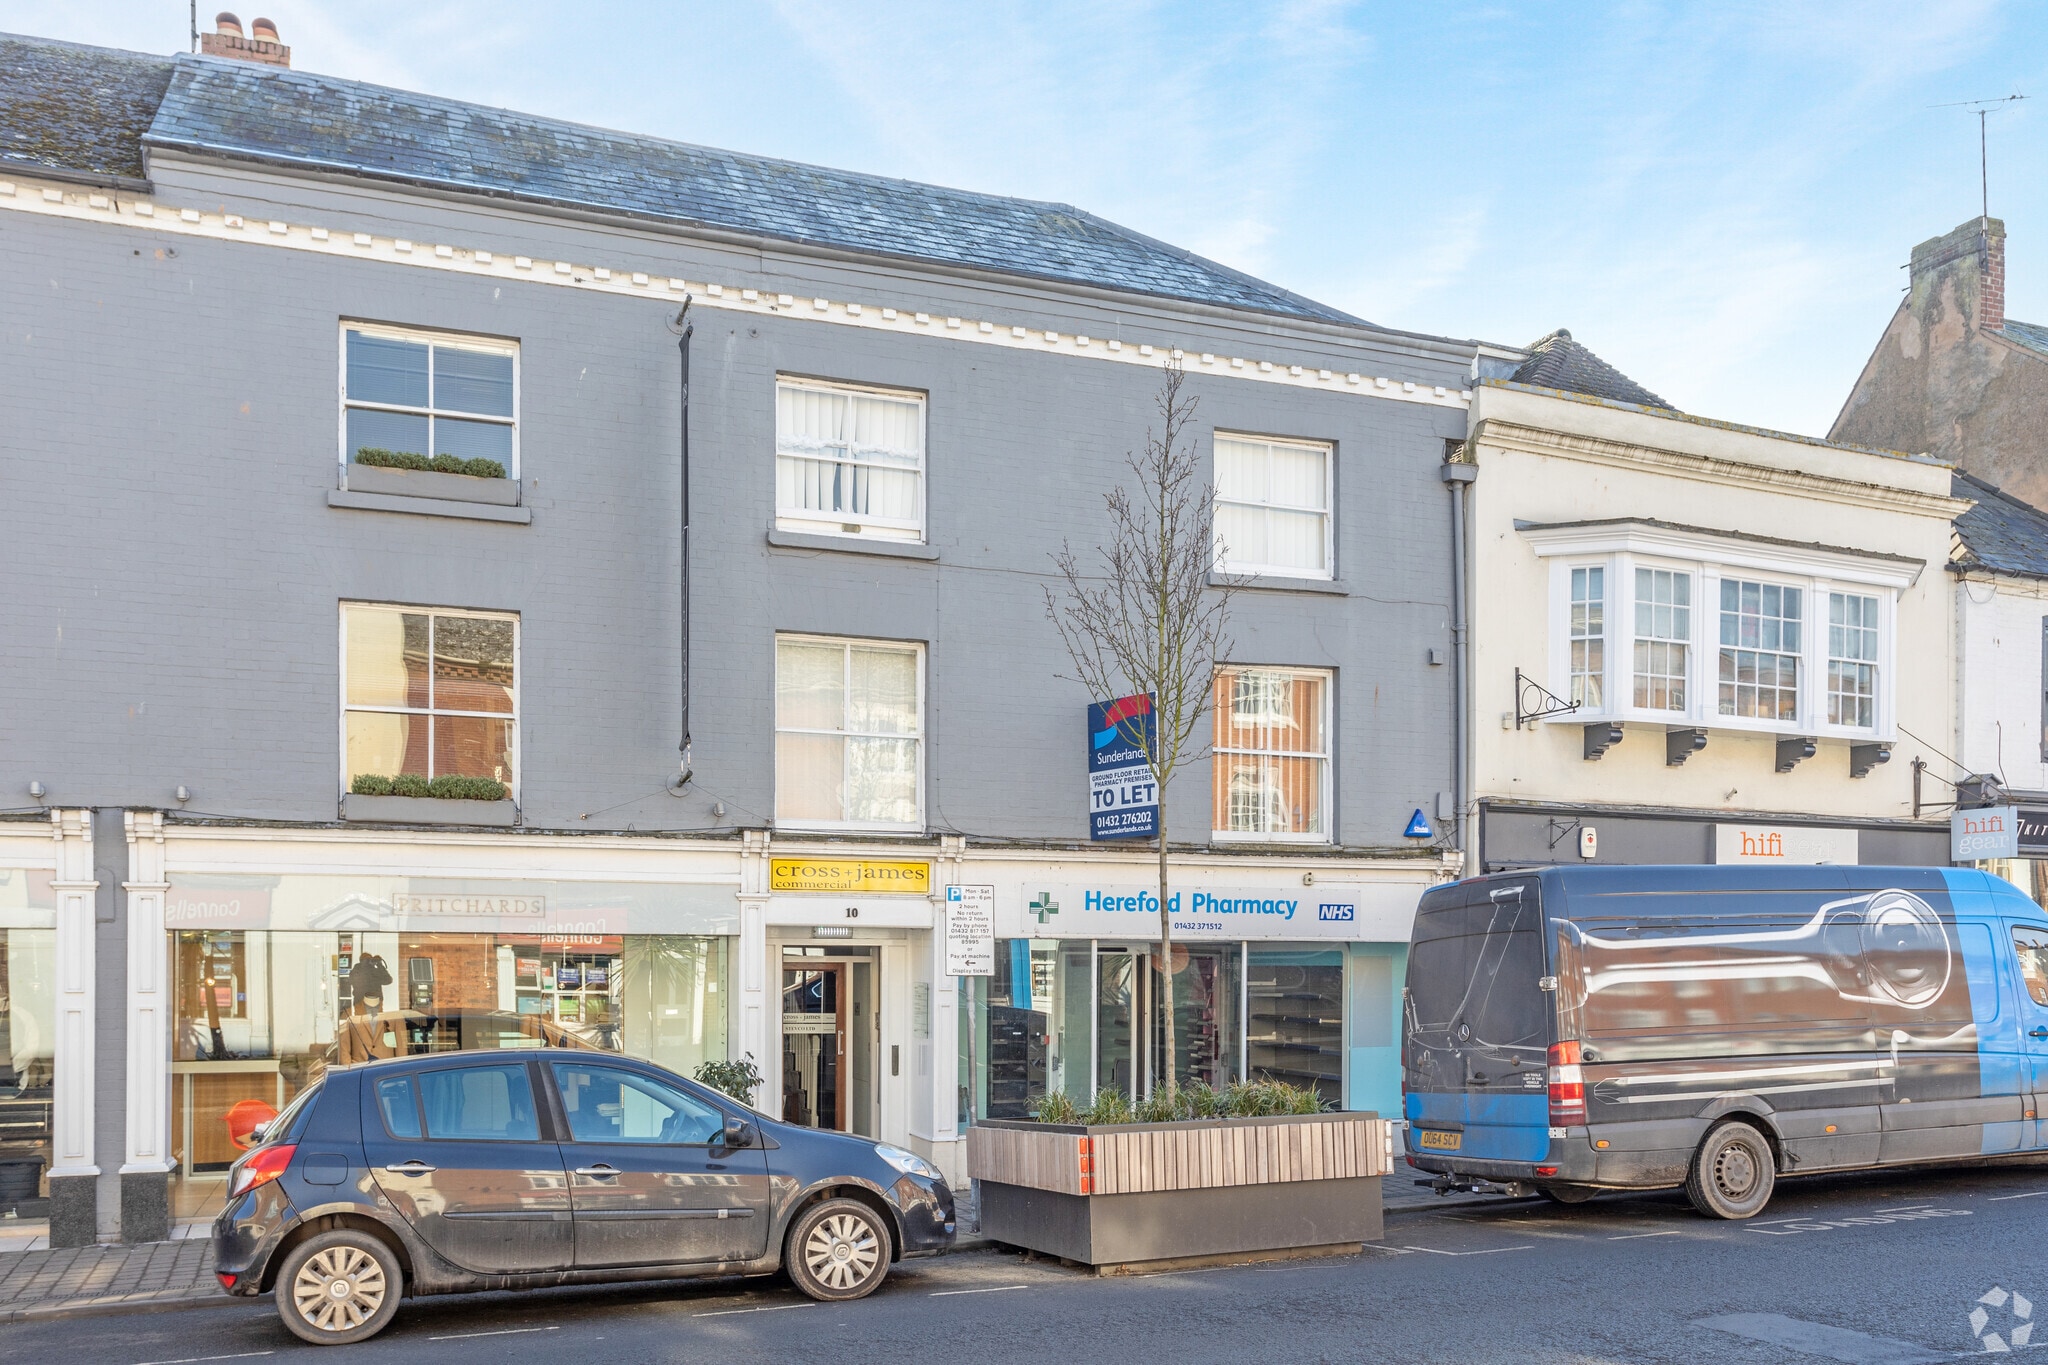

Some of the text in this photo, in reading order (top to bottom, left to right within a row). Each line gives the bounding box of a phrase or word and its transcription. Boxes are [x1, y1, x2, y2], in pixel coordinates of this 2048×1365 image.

[1097, 748, 1147, 765] Sunderlands
[1092, 773, 1114, 782] GROUND
[1114, 771, 1132, 779] FLOOR
[1094, 774, 1152, 788] PHARMACY PREMISES
[1093, 784, 1155, 808] TO LET
[1097, 811, 1152, 828] 01432 276202
[1963, 816, 2004, 834] hifi
[1098, 824, 1152, 836] www.sunderlands.co.uk
[1740, 831, 1836, 860] hifi gear
[1959, 836, 2009, 854] gear
[776, 865, 840, 877] cross
[856, 864, 924, 882] james
[776, 880, 852, 889] commercial
[398, 898, 540, 914] PRITCHARDS
[846, 908, 858, 918] 10
[1085, 890, 1298, 920] Herefod Pharmacy
[1320, 906, 1352, 919] NHS
[1443, 1134, 1458, 1146] SCV
